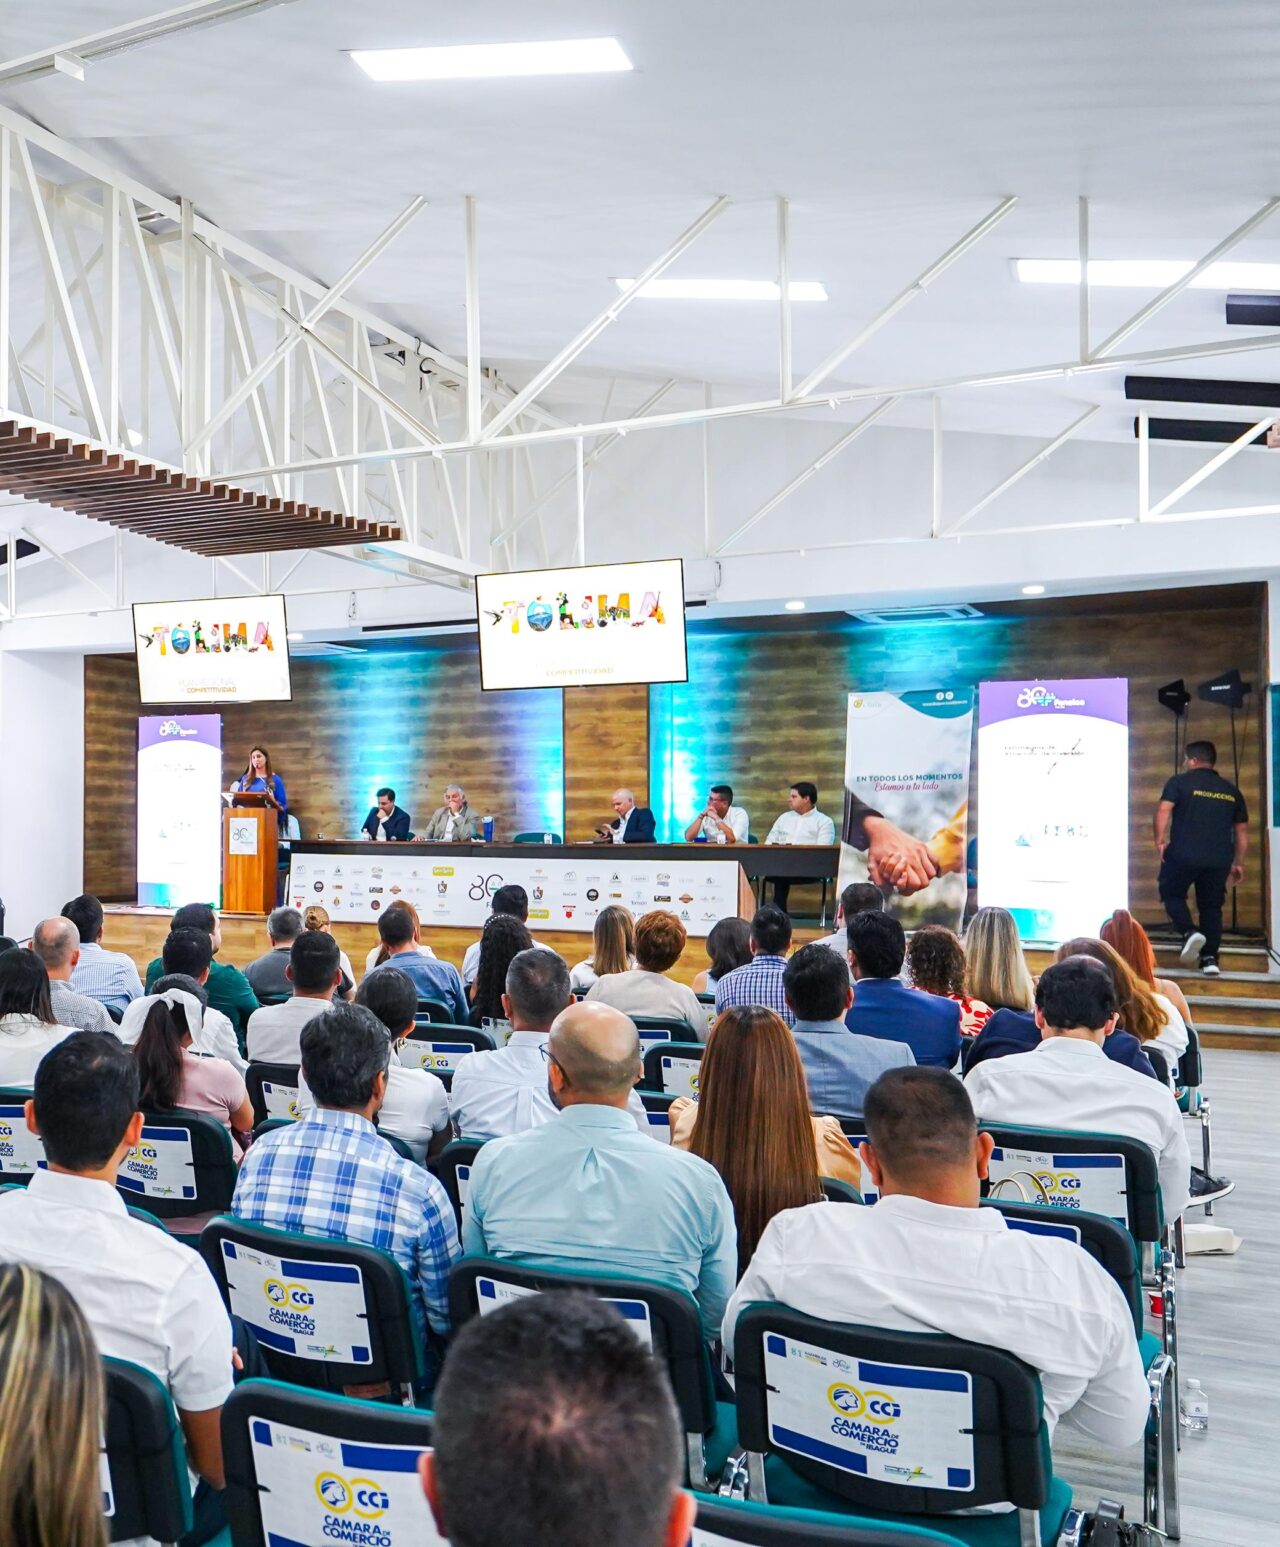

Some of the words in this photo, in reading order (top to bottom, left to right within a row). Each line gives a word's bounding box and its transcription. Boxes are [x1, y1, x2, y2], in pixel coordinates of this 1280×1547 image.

[874, 782, 904, 792] Estamos
[922, 781, 939, 790] lado
[127, 1160, 153, 1171] CAMARA
[268, 1314, 316, 1330] COMERCIO
[269, 1307, 309, 1323] CAMARA
[833, 1416, 891, 1438] CAMARA
[830, 1424, 899, 1448] COMERCIO
[865, 1443, 897, 1455] IBAGUE
[324, 1514, 382, 1535] CAMARA
[322, 1525, 392, 1547] COMERCIO
